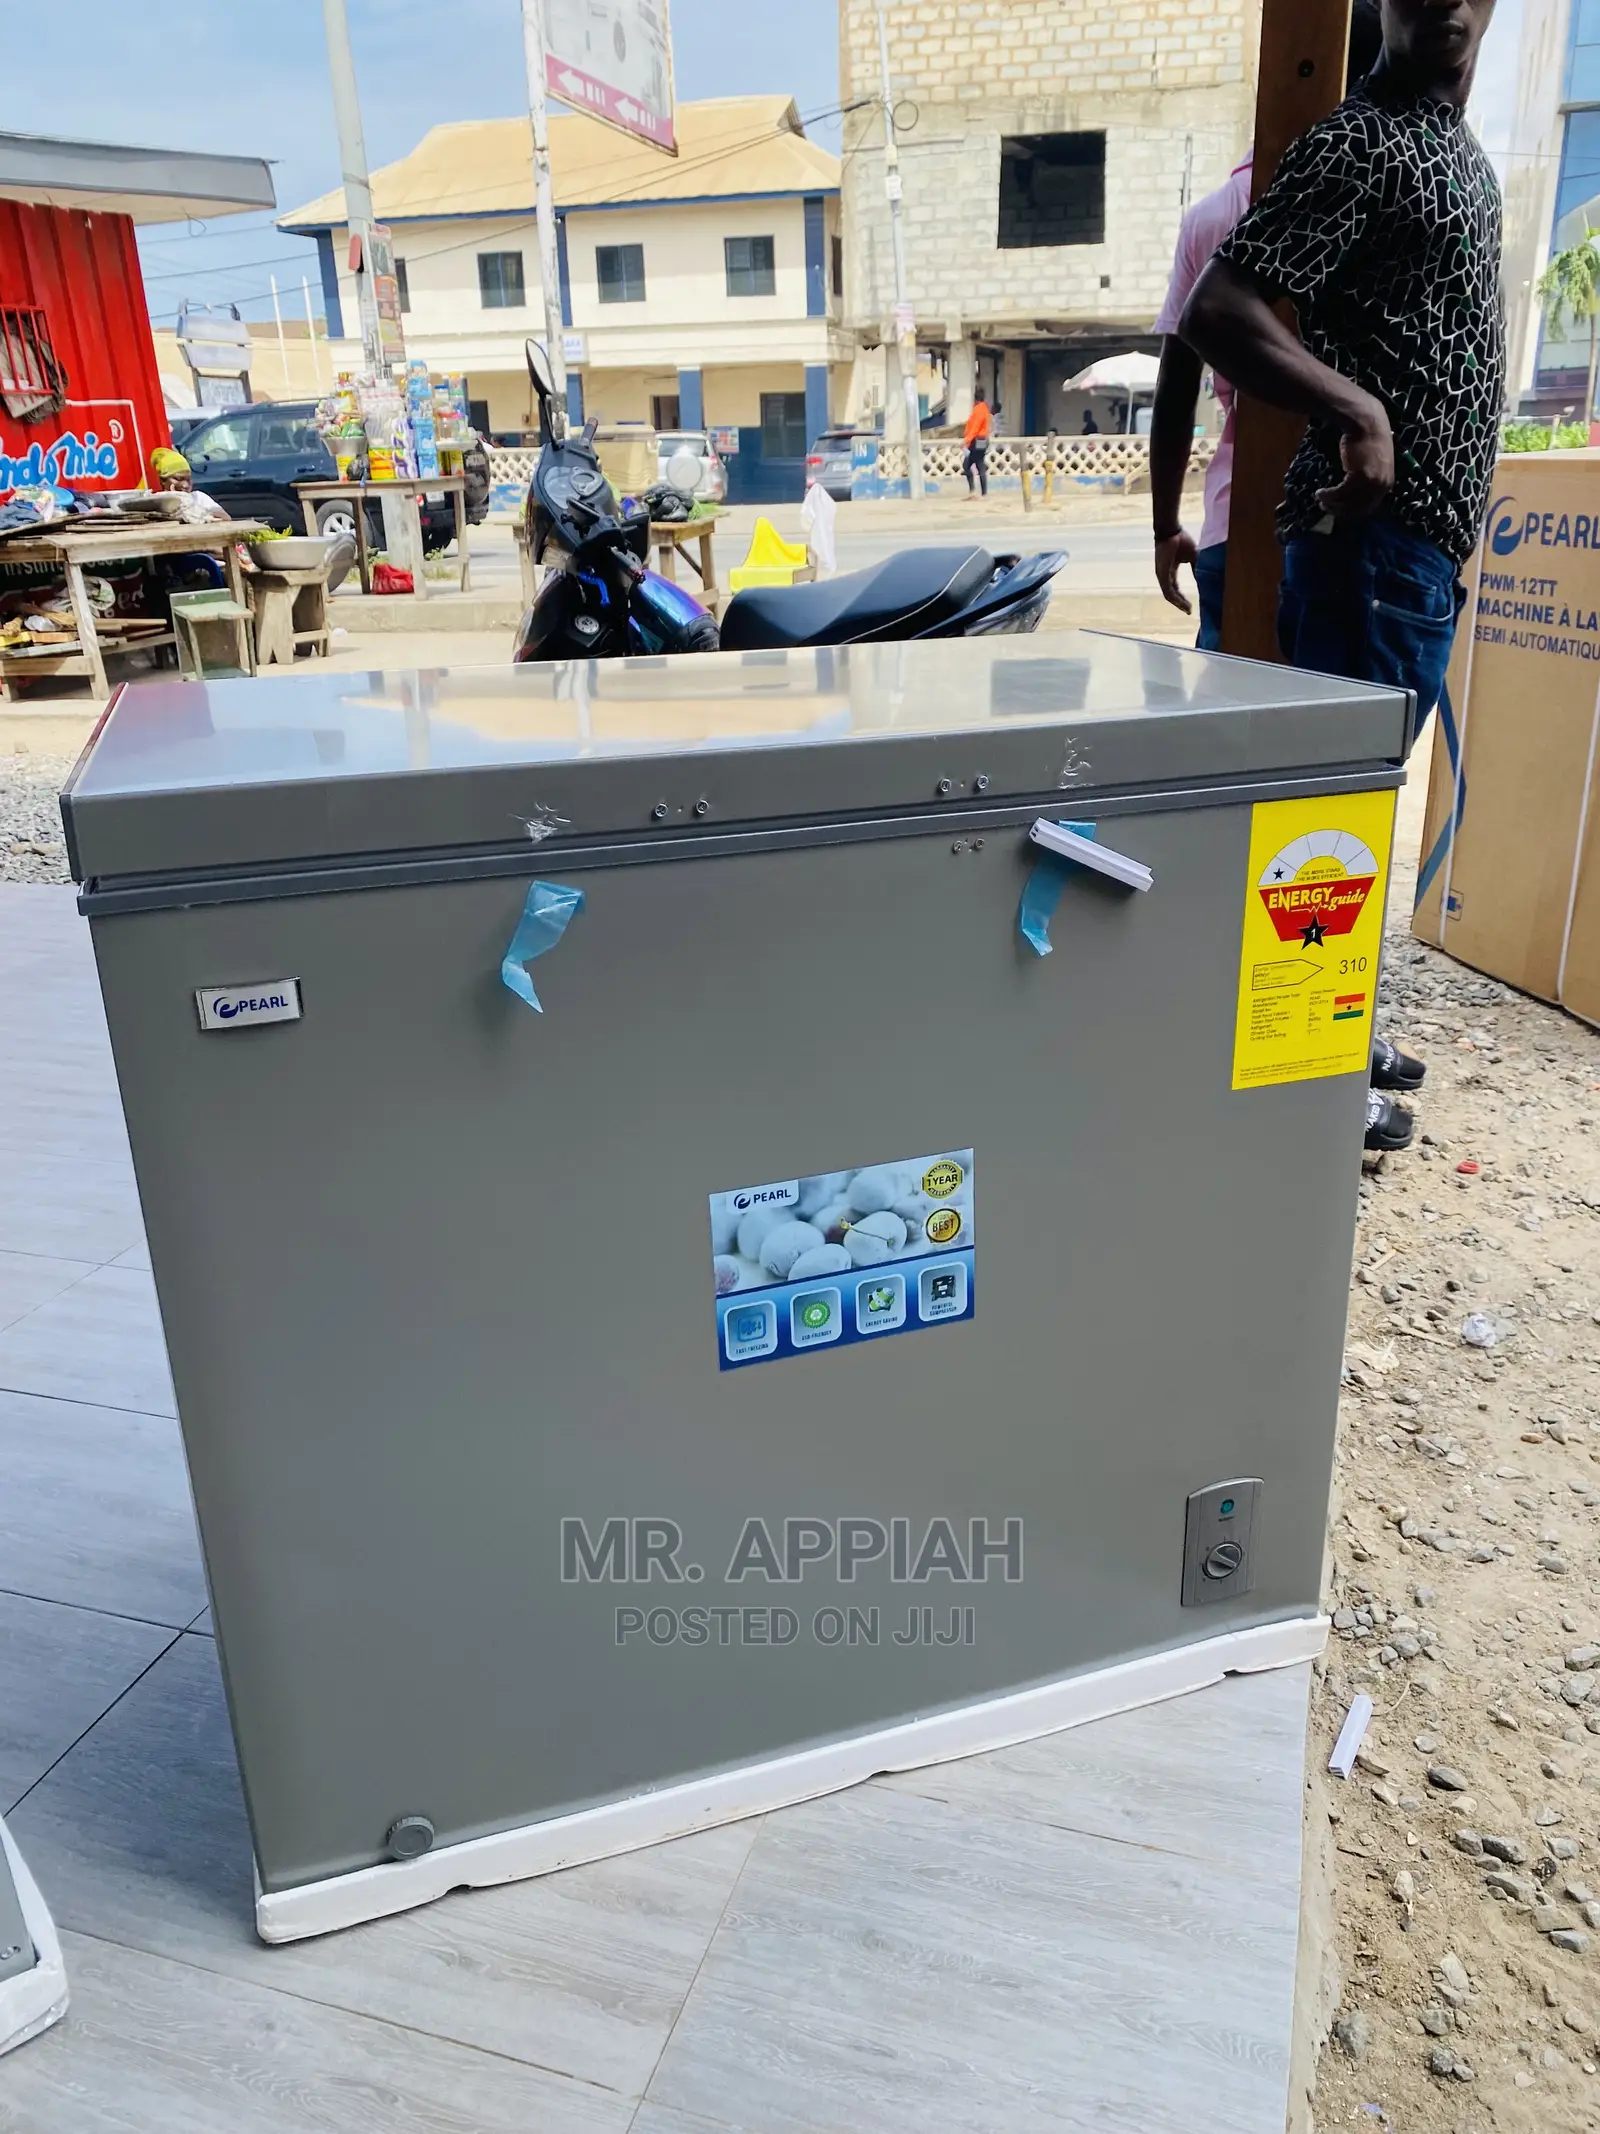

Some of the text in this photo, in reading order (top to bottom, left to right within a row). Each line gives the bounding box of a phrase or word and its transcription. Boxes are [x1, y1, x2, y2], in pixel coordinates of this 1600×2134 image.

[854, 443, 868, 458] IN
[1524, 512, 1600, 550] PEARL
[1480, 572, 1558, 597] PWM-12TT
[1477, 597, 1600, 632] MACHINE À LA
[1268, 887, 1366, 913] ENERGY guide
[1310, 928, 1317, 939] 1
[1339, 956, 1368, 975] 310
[239, 995, 289, 1013] PEARL
[926, 1173, 959, 1187] 1 YEAR
[753, 1188, 791, 1204] PEARL
[932, 1218, 955, 1233] BEST
